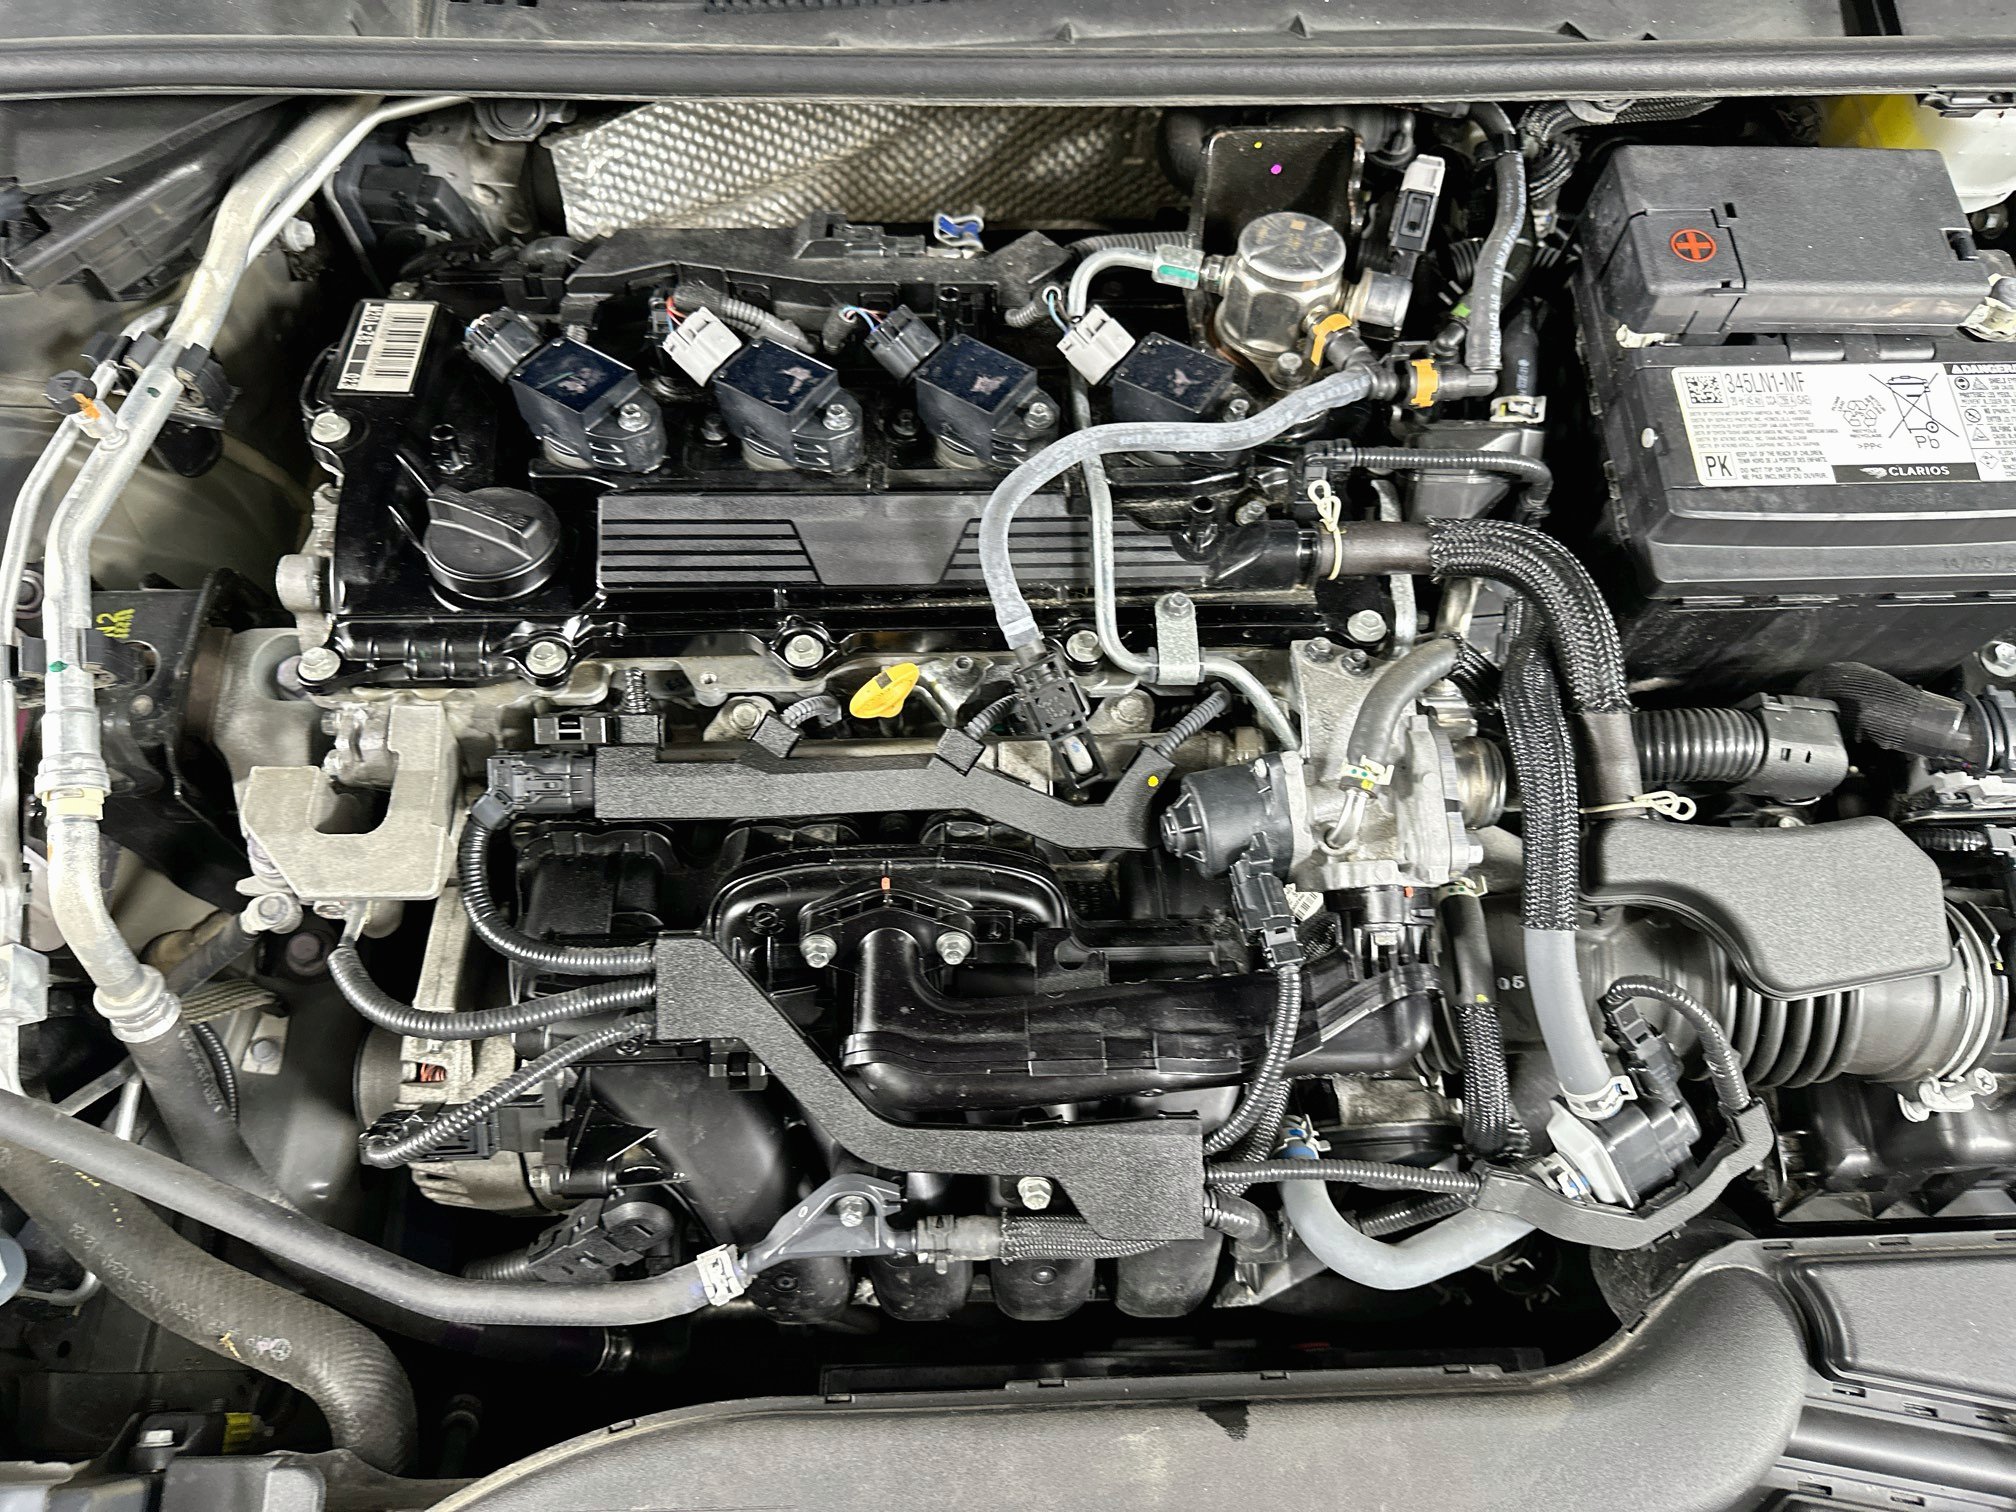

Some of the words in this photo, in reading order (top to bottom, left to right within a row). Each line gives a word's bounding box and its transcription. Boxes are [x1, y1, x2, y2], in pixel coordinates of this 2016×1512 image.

[1725, 372, 1805, 394] 345LN1-MF
[1914, 435, 1940, 449] Pb
[1705, 455, 1733, 477] PK
[1888, 466, 1951, 477] CLARIOS
